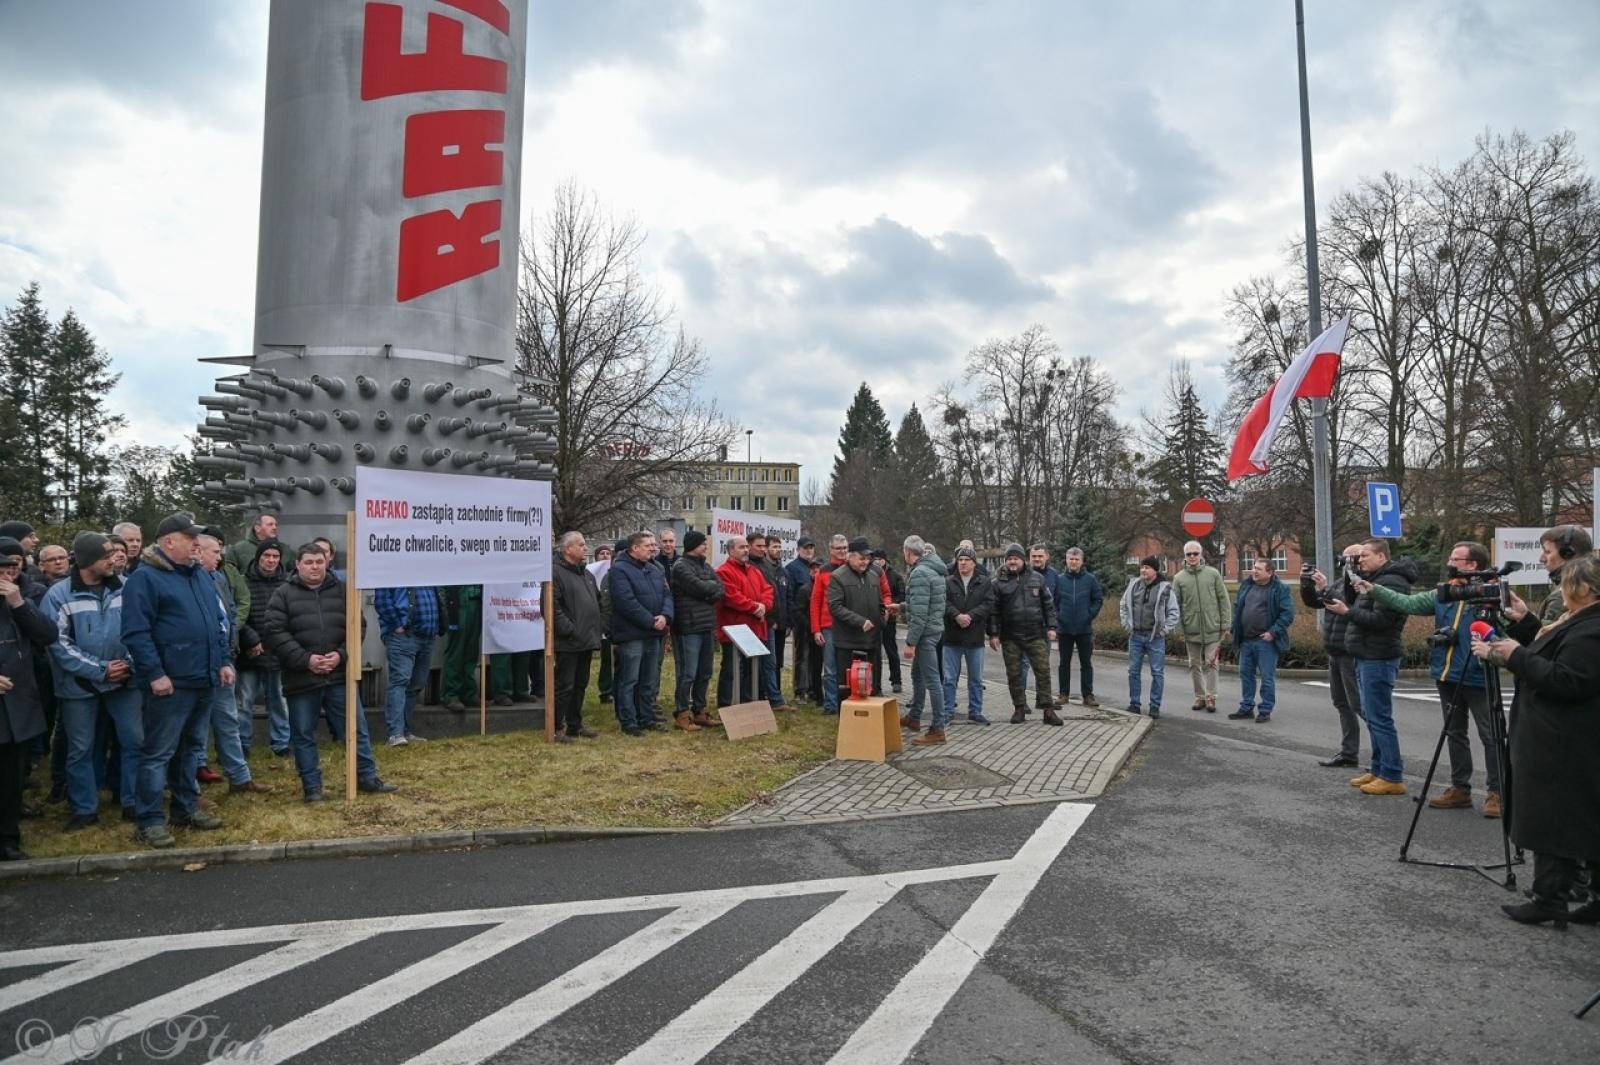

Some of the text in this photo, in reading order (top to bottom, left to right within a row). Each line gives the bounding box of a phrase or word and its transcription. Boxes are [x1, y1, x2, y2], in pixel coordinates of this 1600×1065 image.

[366, 499, 543, 527] RAFAKO zastąpią zachodnie firmy(?!)
[1375, 488, 1394, 521] P
[717, 518, 744, 535] RAFAKO
[369, 533, 541, 555] Cudze chwalicie, swego nie znacie!
